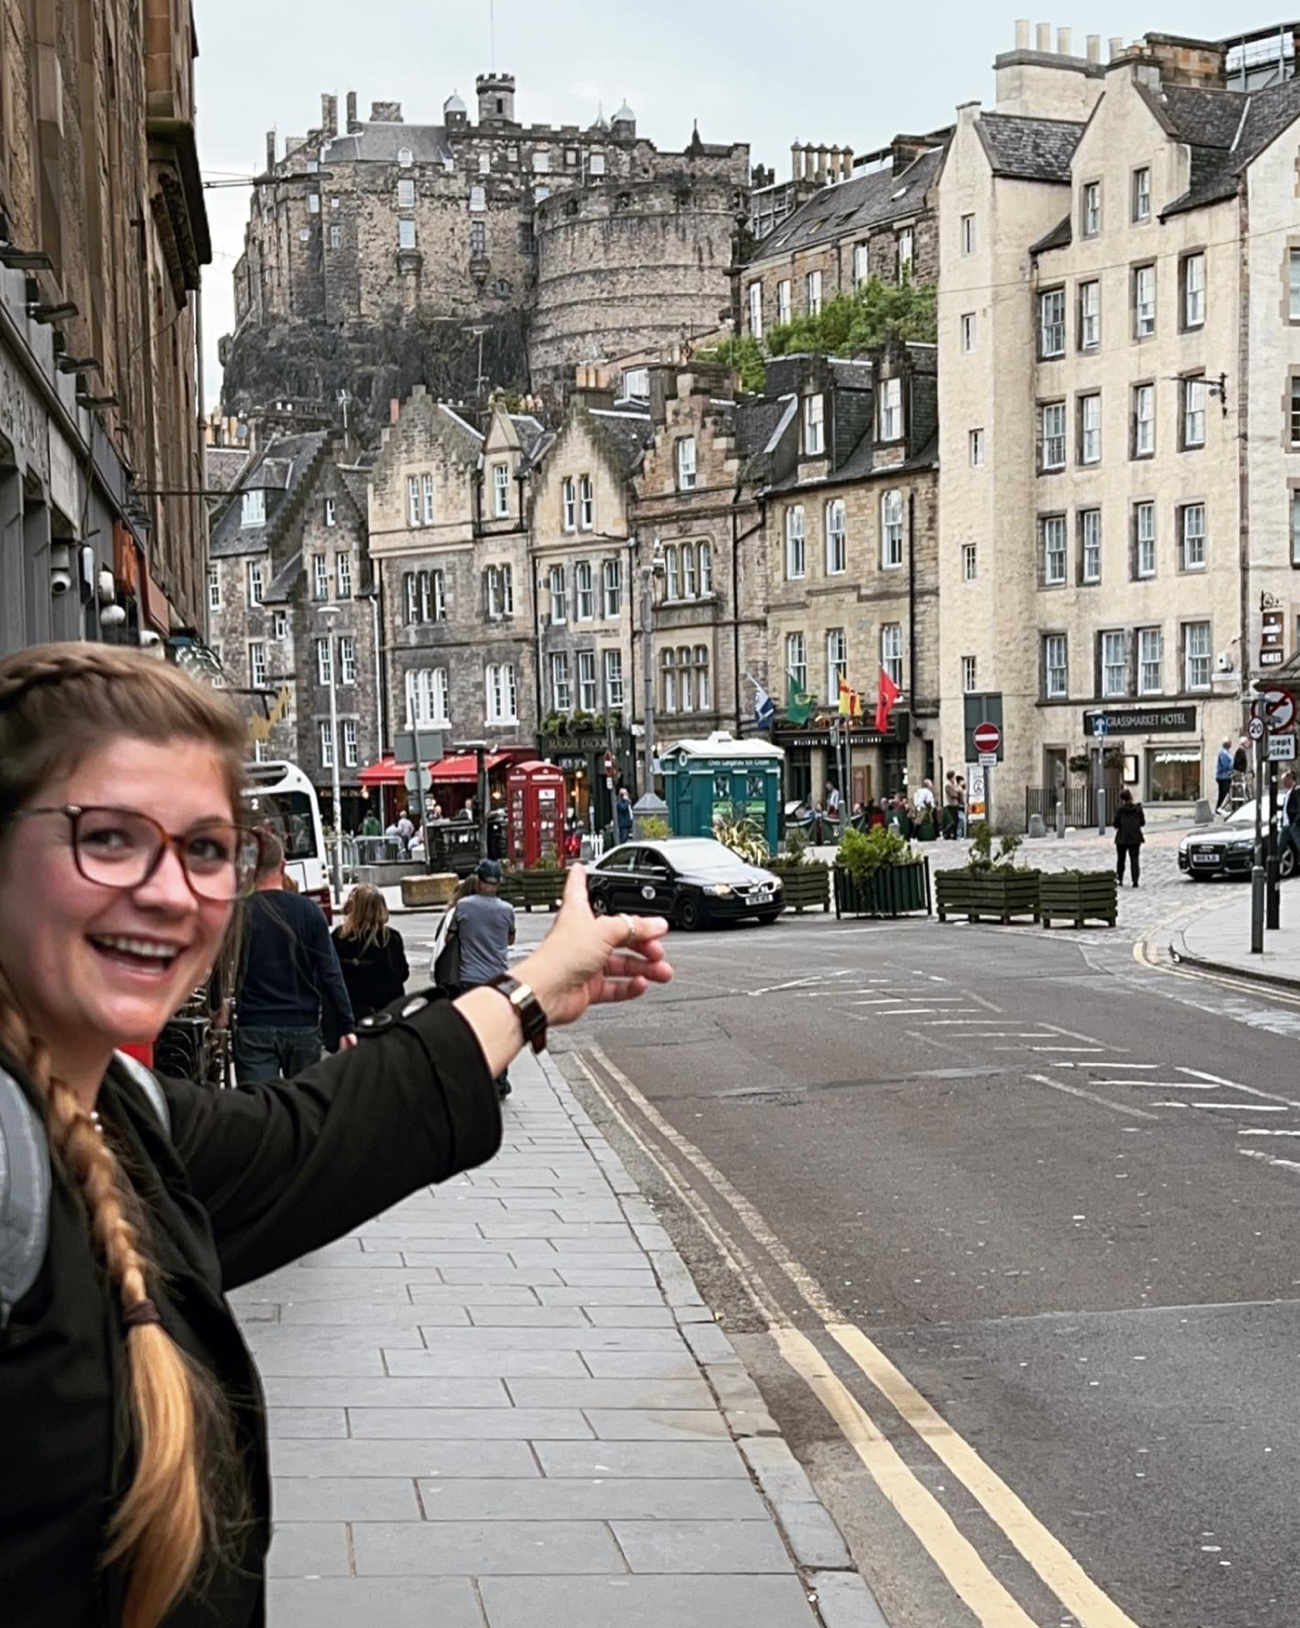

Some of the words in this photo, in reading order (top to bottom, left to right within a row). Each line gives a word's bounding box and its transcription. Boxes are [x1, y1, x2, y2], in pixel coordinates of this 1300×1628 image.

[1106, 715, 1159, 727] GRASSMARKET
[1160, 713, 1187, 725] HOTEL
[1251, 723, 1262, 734] 20
[1270, 738, 1291, 746] cept
[251, 798, 259, 811] 2
